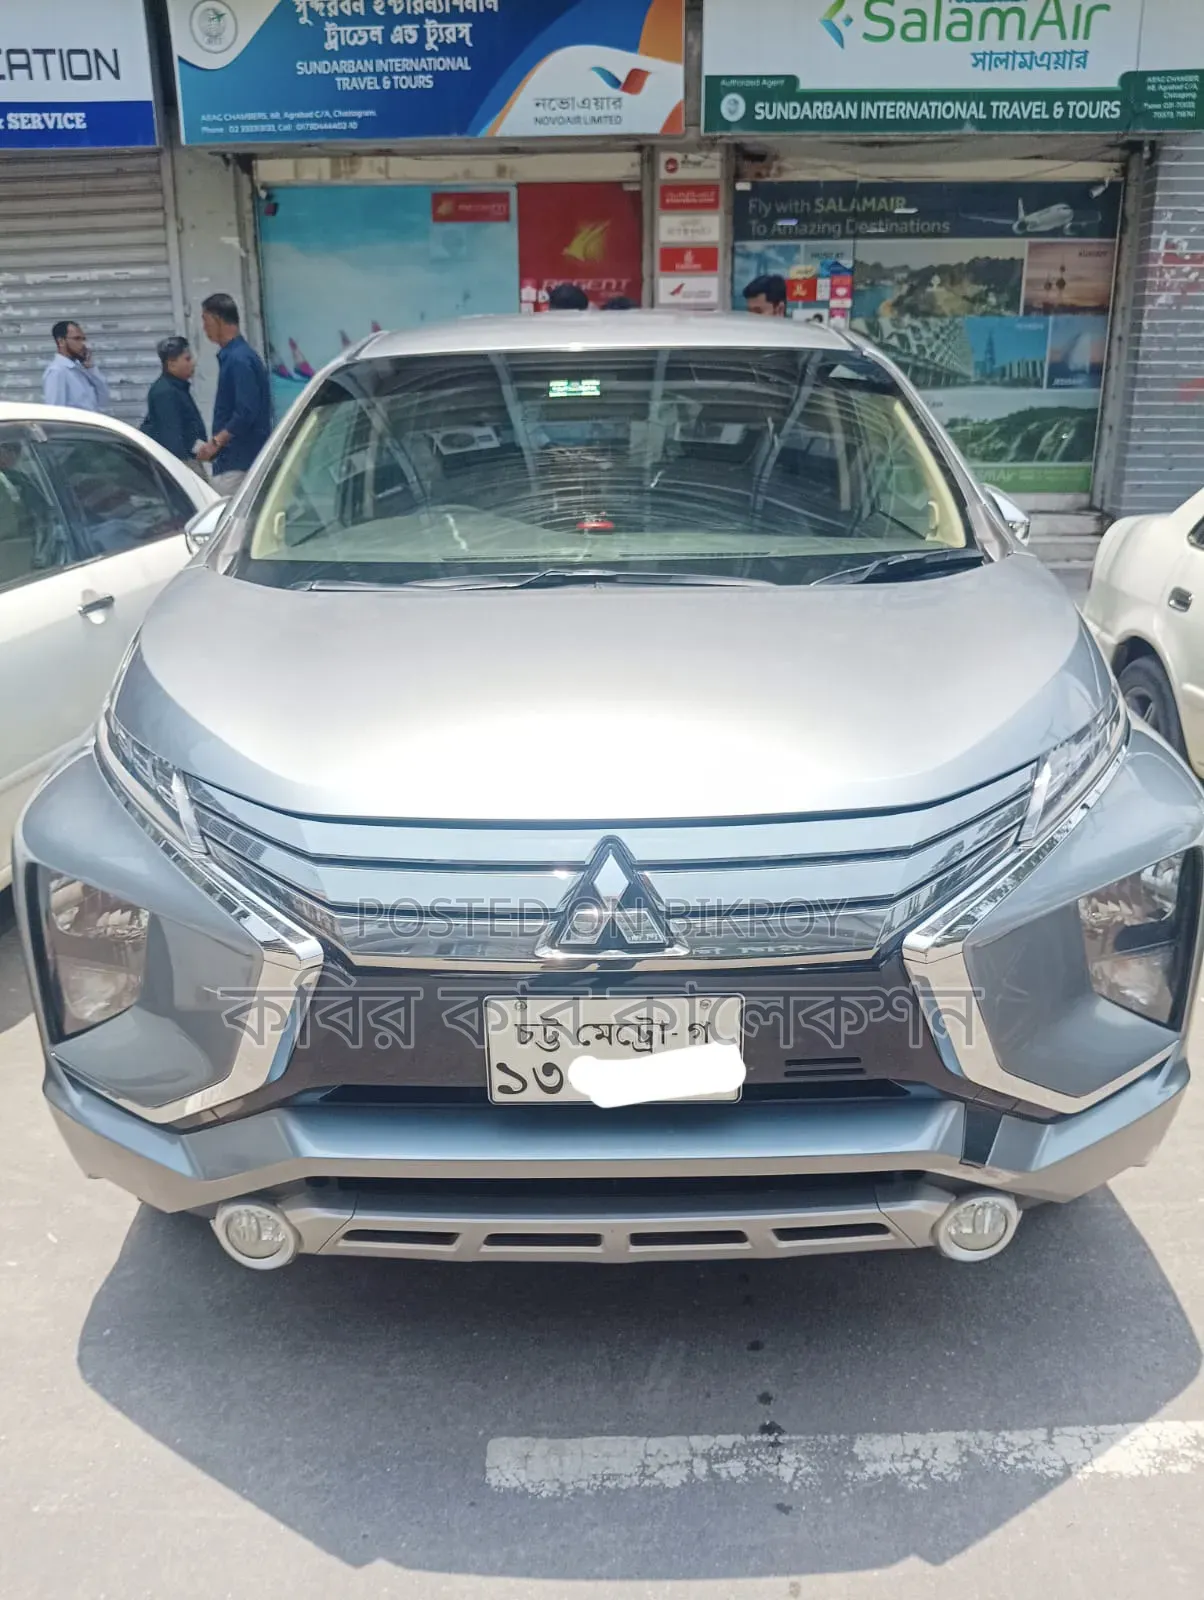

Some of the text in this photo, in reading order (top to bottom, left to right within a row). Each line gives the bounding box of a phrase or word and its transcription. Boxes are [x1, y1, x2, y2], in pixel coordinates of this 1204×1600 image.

[862, 0, 1112, 43] SalamAir
[0, 48, 121, 81] ATION
[296, 56, 472, 76] SUNDARBAN INTERNATIONAL
[334, 75, 434, 91] TRAVEL & TOURS
[754, 100, 1122, 120] SUNDARBAN INTERNATIONAL TRAVEL & TOURS
[6, 112, 87, 130] SERVICE
[748, 196, 907, 217] Fly with SALAMAIR
[748, 216, 951, 240] To Amazing Destinations
